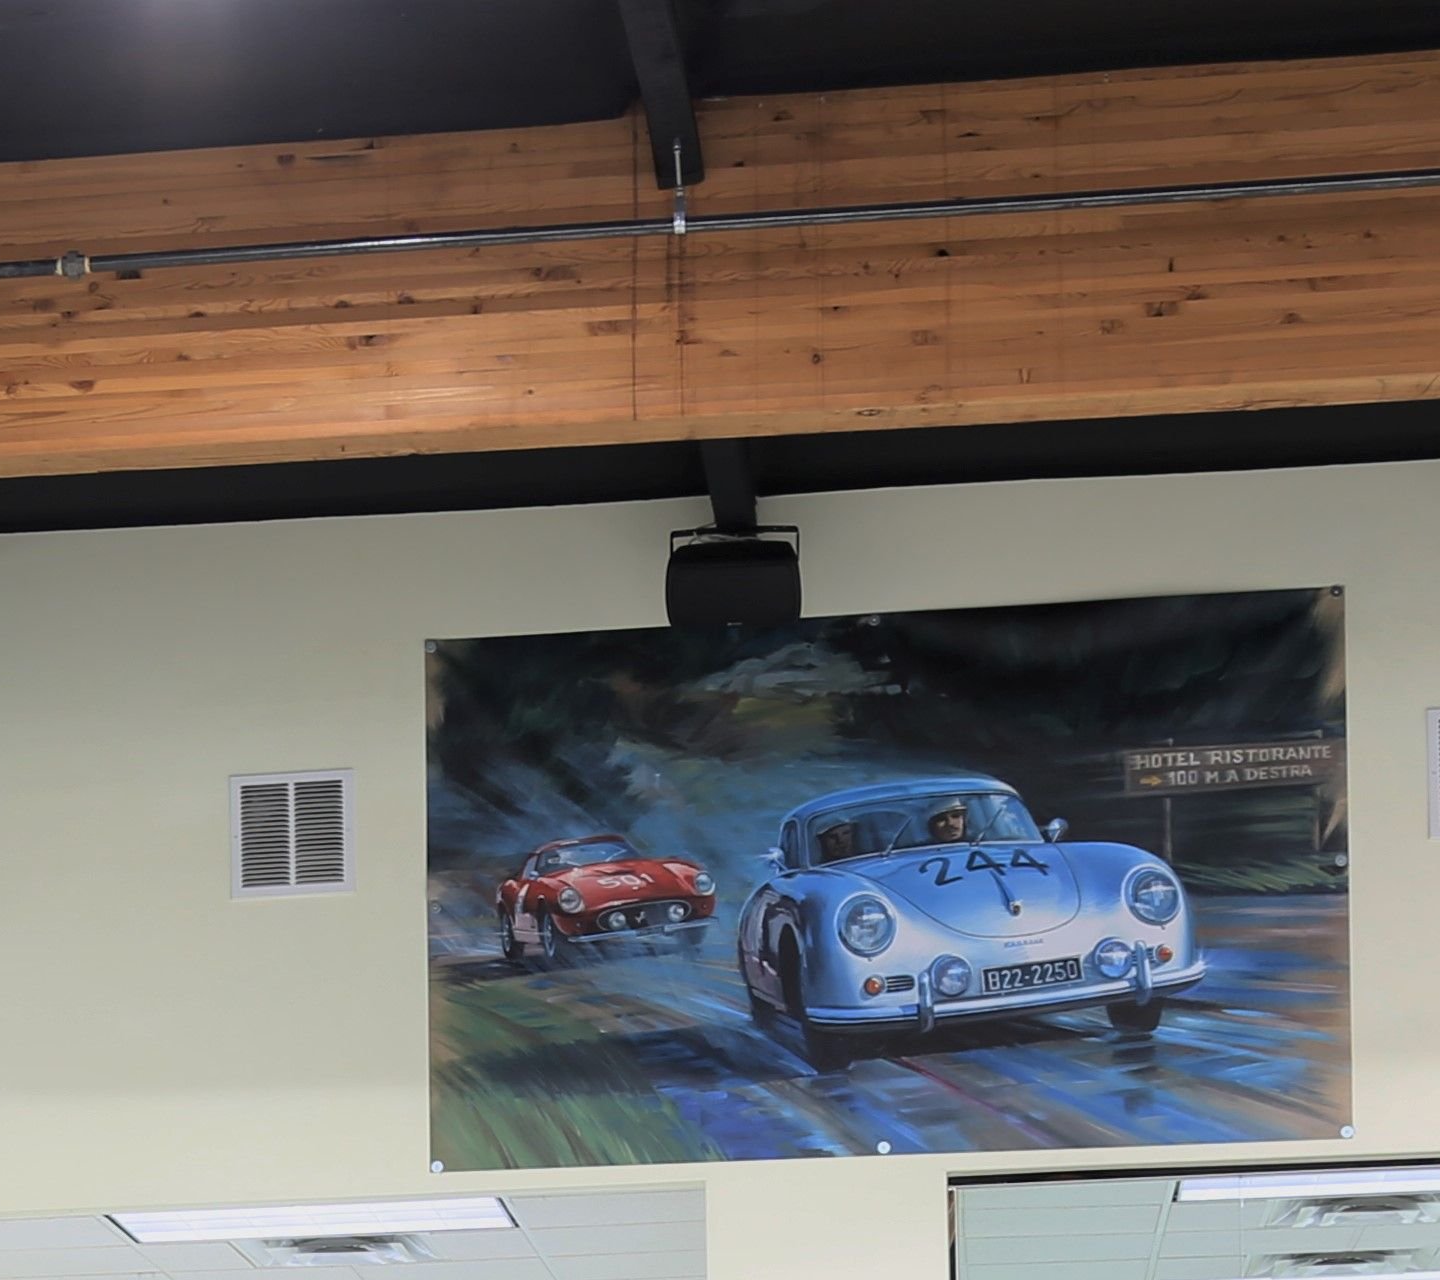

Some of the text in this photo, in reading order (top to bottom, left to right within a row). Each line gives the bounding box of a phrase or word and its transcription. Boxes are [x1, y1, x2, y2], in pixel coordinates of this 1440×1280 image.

[1131, 745, 1332, 770] HOTEL RISTORANTE
[1164, 769, 1198, 786] 100
[1244, 764, 1313, 781] DESTRA
[919, 849, 1050, 886] 244
